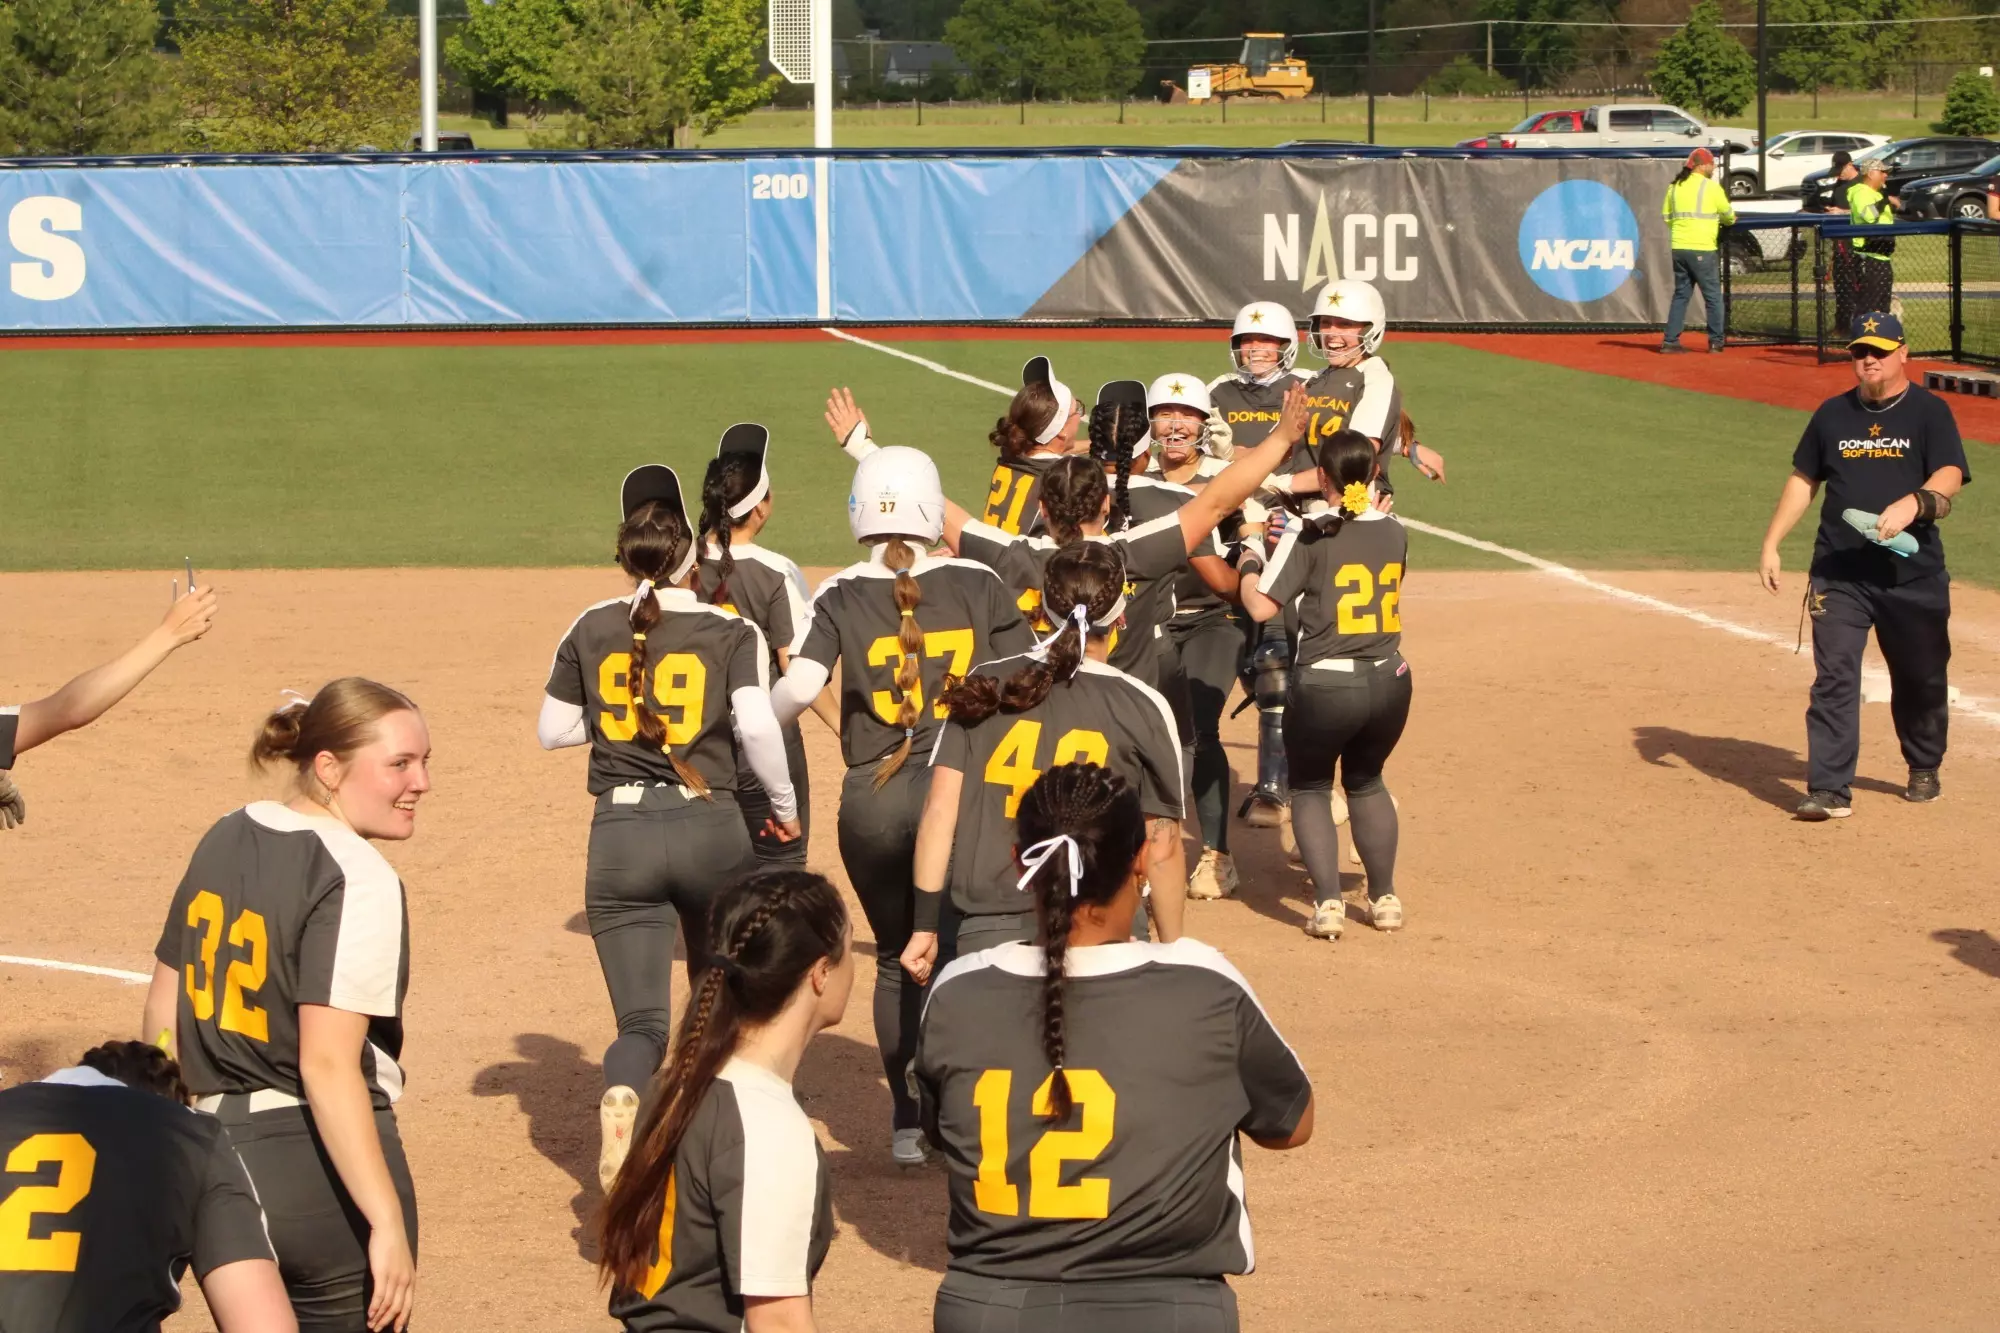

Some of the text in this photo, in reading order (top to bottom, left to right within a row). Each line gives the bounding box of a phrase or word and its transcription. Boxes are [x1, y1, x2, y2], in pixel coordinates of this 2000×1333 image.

[752, 174, 808, 199] 200
[8, 196, 86, 300] S
[1263, 187, 1418, 293] NACC
[1531, 239, 1635, 270] NCAA
[1228, 411, 1281, 424] DOMINI
[1308, 412, 1343, 445] 14
[1838, 438, 1910, 450] DOMINICAN
[1843, 449, 1904, 458] SOFTBALL
[880, 501, 896, 513] 37
[983, 464, 1035, 536] 21
[1334, 563, 1402, 635] 22
[598, 653, 707, 745] 99
[867, 628, 974, 725] 37
[186, 890, 269, 1043] 32
[973, 1069, 1116, 1218] 12
[0, 1133, 97, 1272] 2
